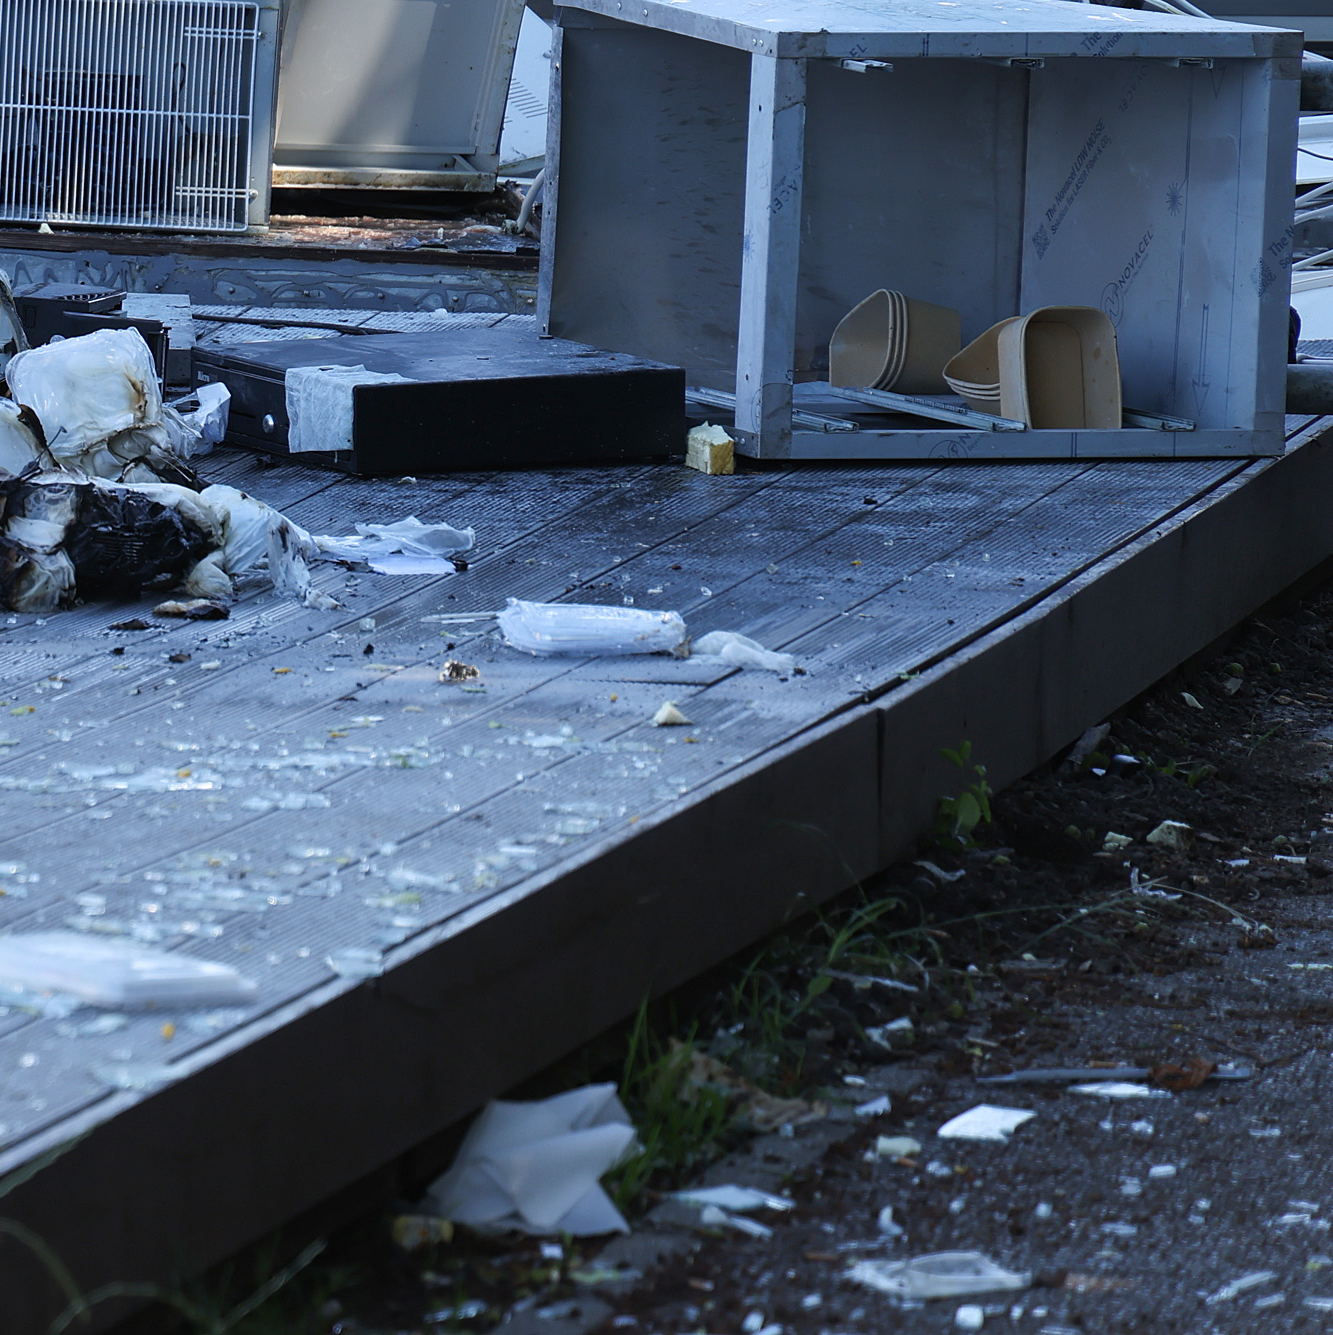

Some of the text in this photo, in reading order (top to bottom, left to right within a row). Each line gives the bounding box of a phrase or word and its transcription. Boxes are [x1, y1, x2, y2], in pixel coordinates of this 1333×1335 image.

[1080, 32, 1102, 51] The
[1268, 236, 1289, 257] The
[1118, 229, 1154, 289] NOVACEL
